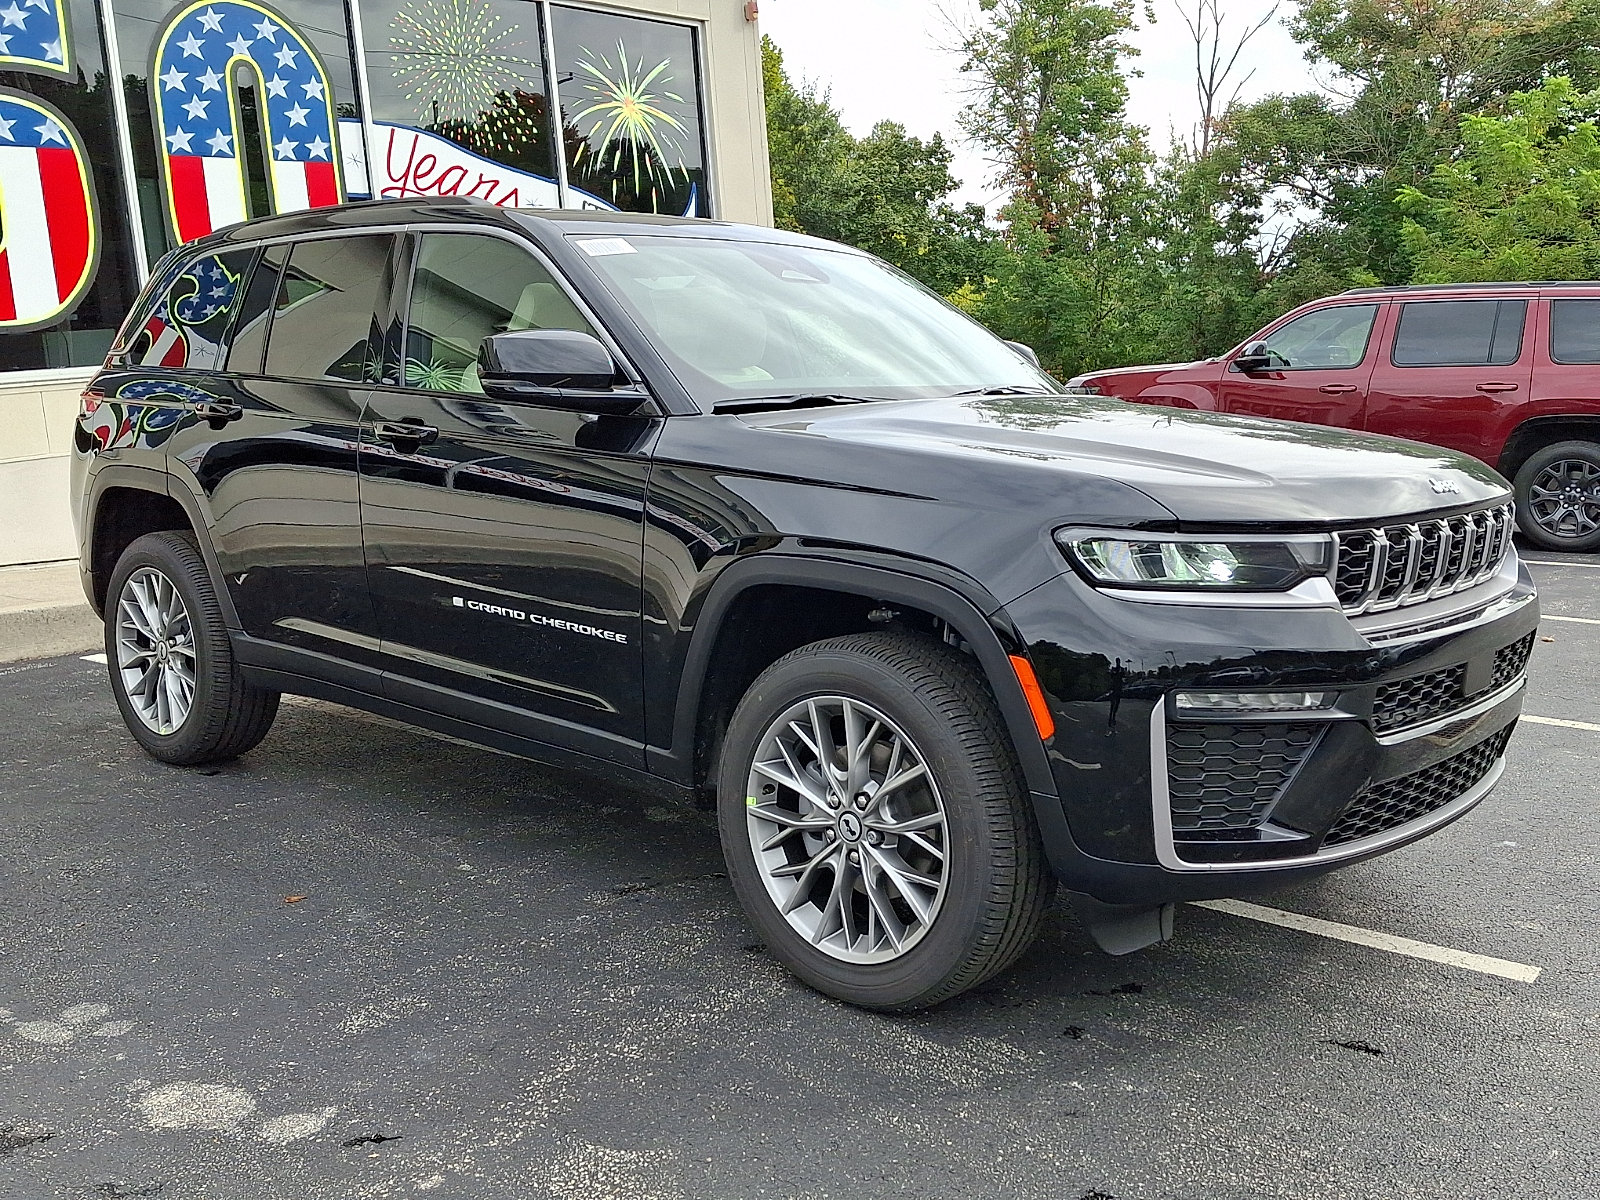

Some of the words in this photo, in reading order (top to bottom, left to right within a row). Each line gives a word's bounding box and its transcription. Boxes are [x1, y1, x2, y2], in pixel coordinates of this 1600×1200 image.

[1428, 477, 1460, 495] Jeep
[467, 600, 526, 620] GRAND
[529, 613, 628, 645] CHEROKEE
